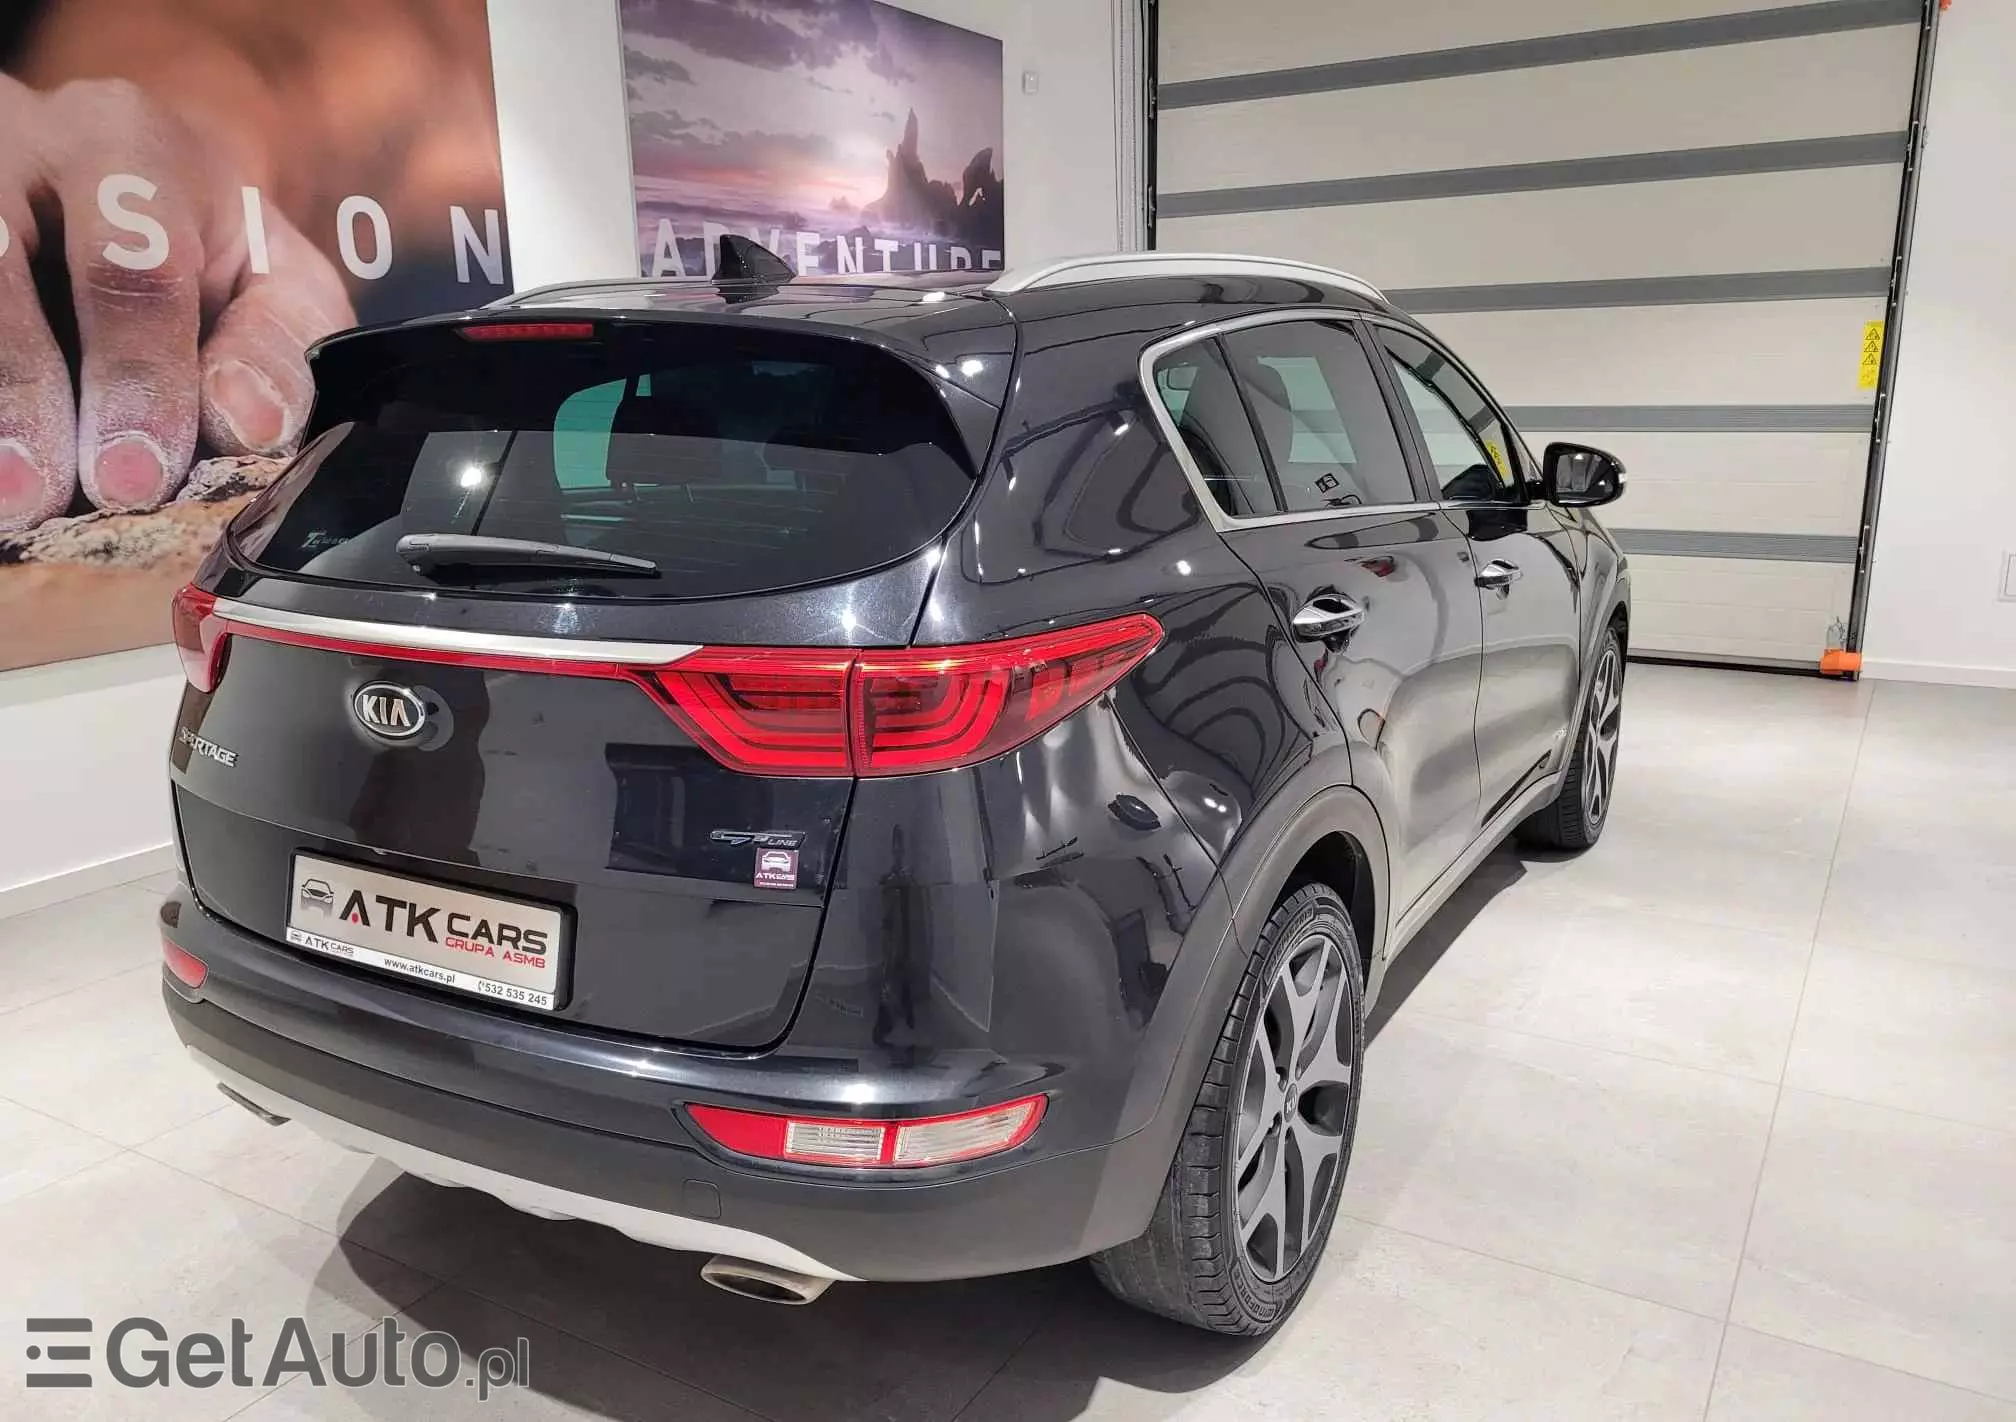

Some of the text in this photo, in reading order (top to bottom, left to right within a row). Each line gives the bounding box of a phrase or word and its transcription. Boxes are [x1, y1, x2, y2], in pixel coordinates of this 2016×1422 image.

[0, 173, 506, 285] SION
[362, 694, 411, 727] KIA
[339, 889, 548, 955] ATK CARS
[304, 936, 329, 950] ATK
[330, 943, 354, 954] CARS
[445, 936, 546, 968] GRUPA ASMB
[383, 957, 456, 984] www.atkcars.pl
[485, 982, 547, 1006] 532 535 245
